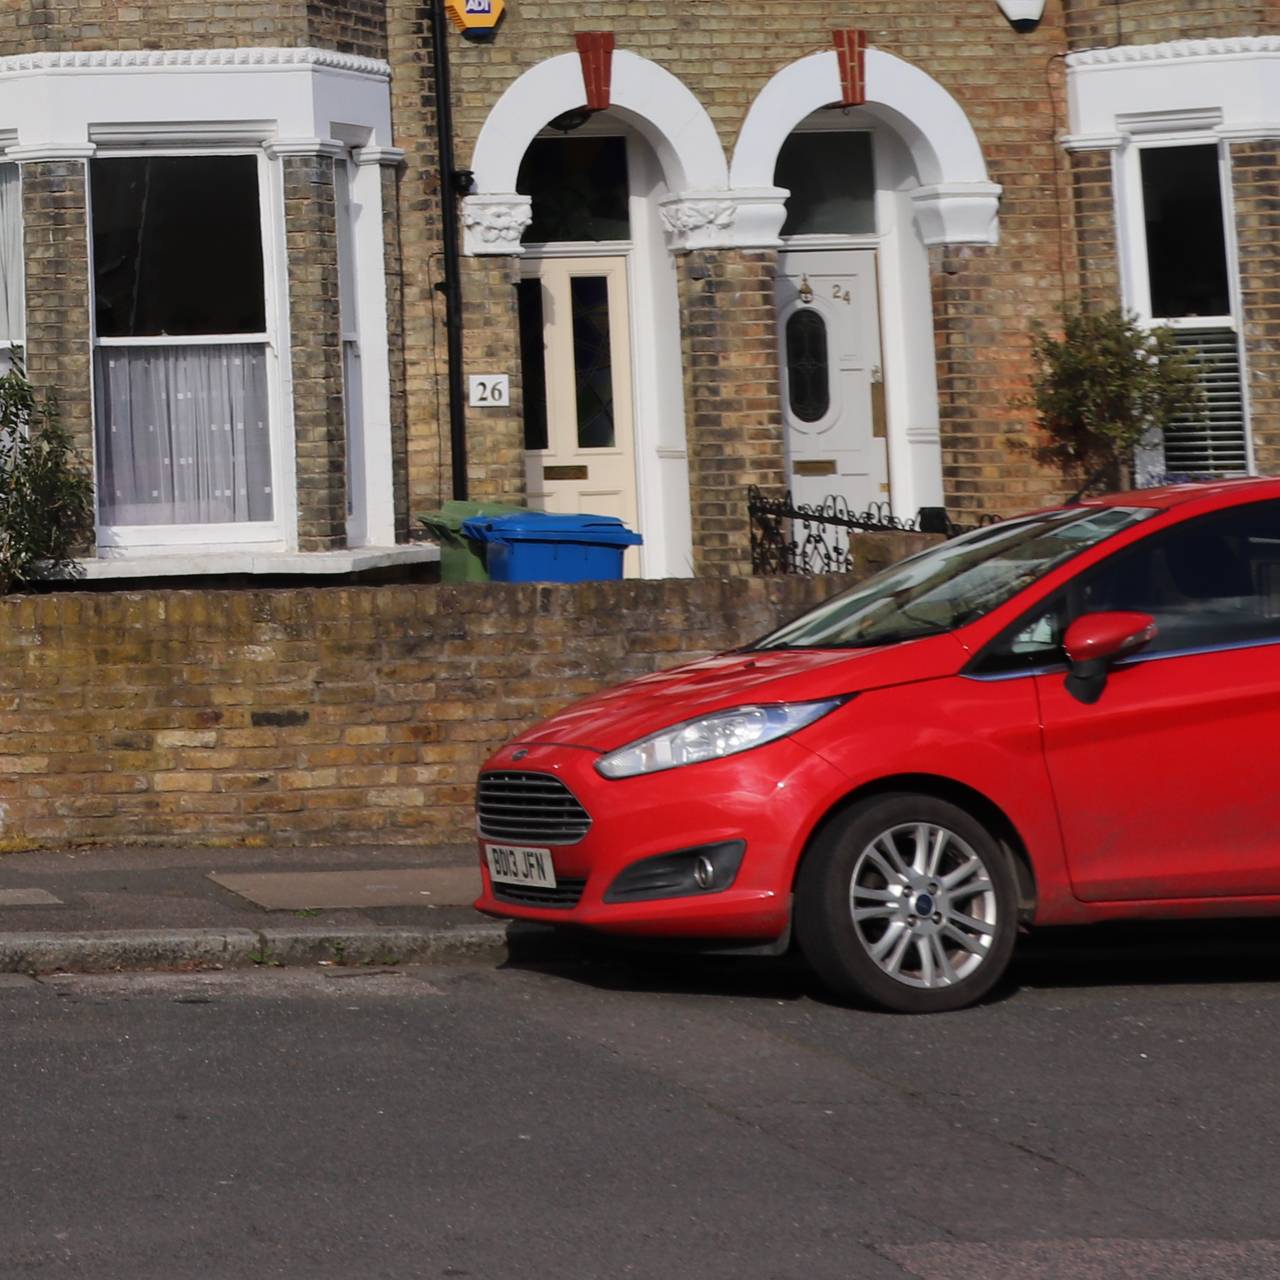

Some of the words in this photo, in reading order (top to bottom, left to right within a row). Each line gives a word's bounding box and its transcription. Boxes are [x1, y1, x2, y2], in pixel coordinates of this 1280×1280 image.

[831, 283, 851, 305] 24
[476, 380, 504, 402] 26
[491, 847, 519, 878] BD13
[522, 850, 547, 881] JFN
